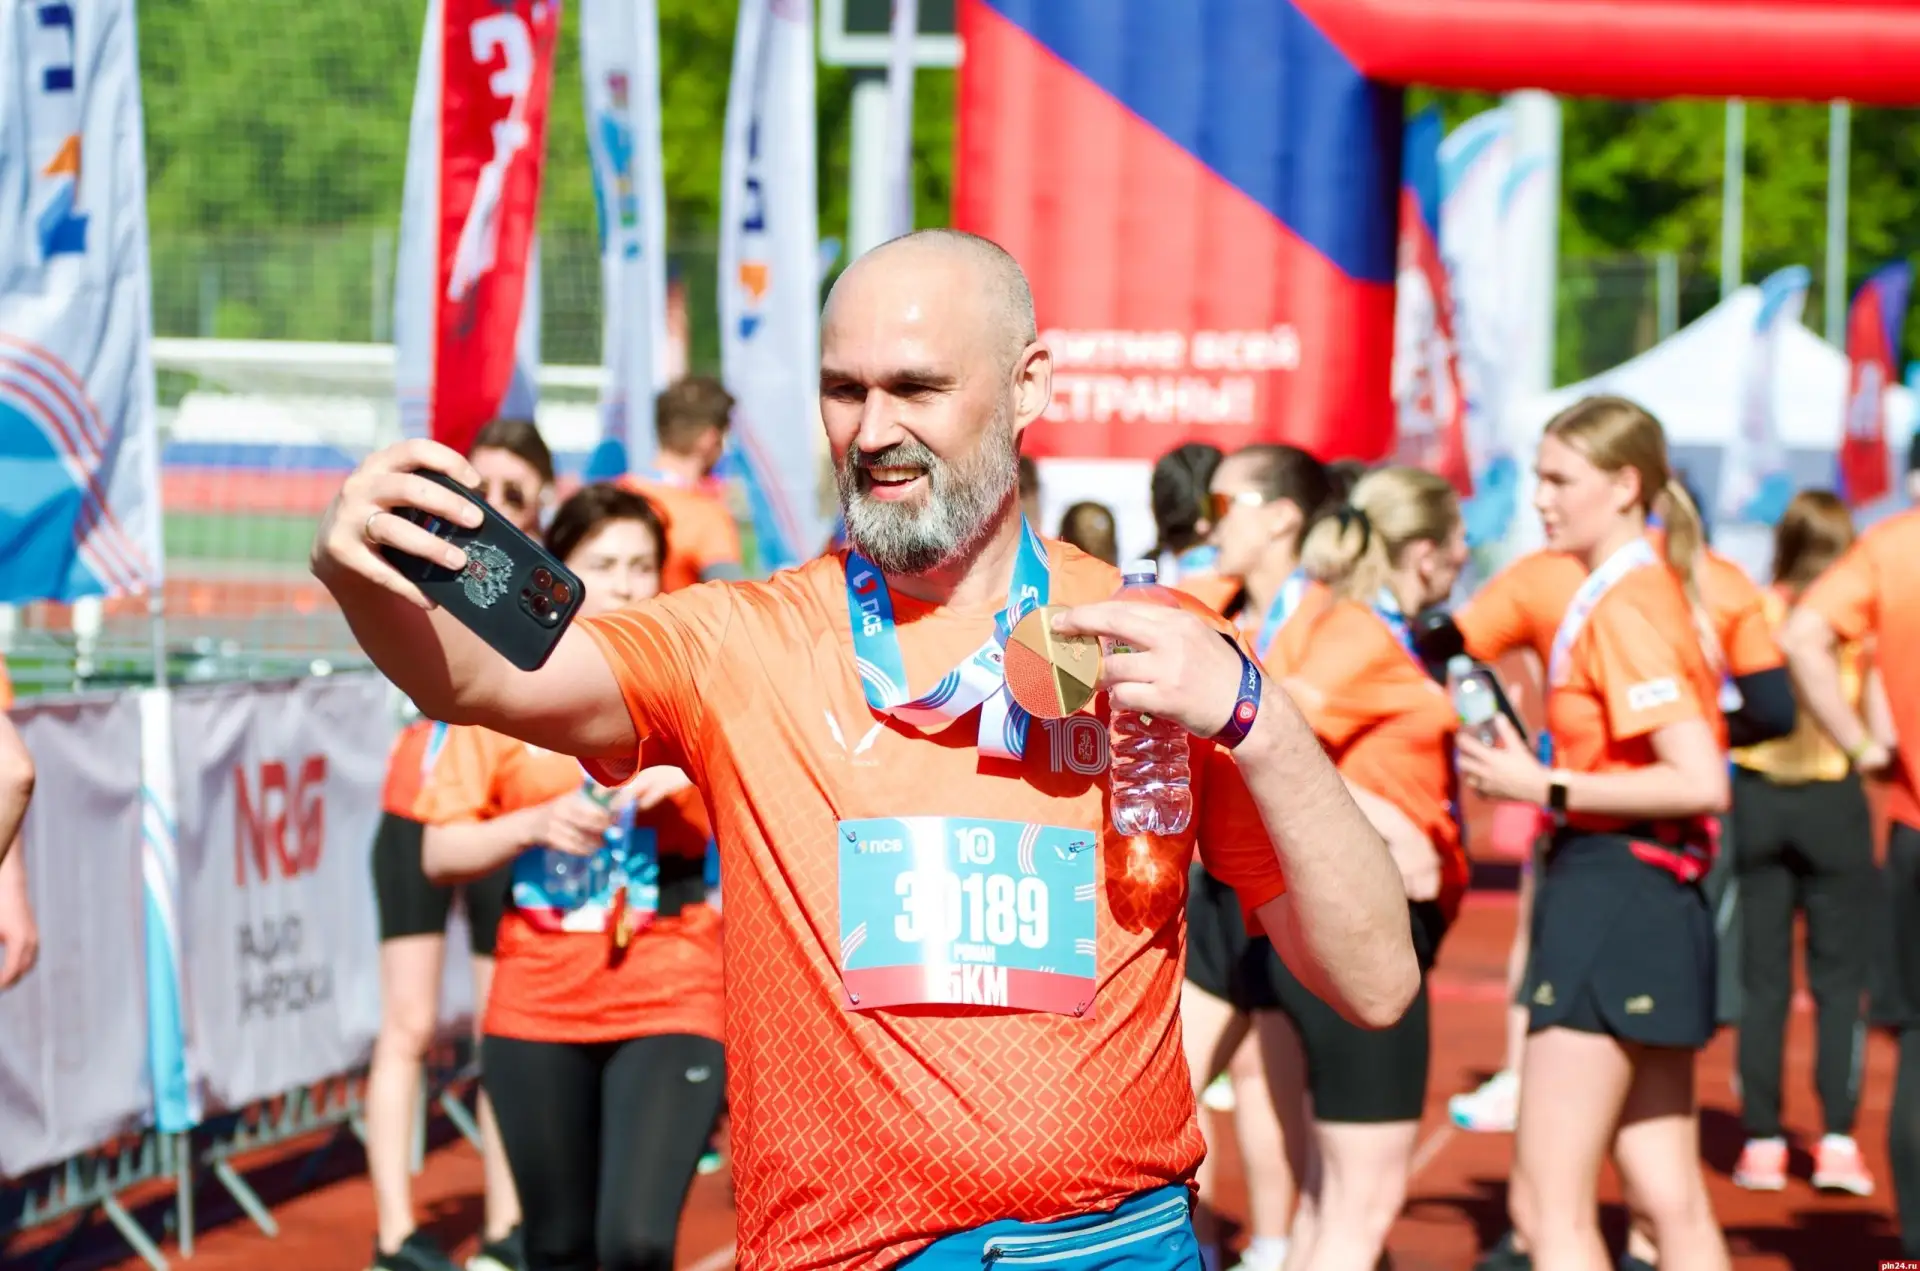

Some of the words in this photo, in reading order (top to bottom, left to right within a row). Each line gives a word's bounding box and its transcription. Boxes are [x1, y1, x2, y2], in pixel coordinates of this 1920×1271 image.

[861, 597, 883, 638] ПСБ
[1040, 716, 1110, 776] 10
[869, 838, 903, 855] ПСБ
[954, 827, 996, 865] 10
[894, 870, 1050, 950] 30189
